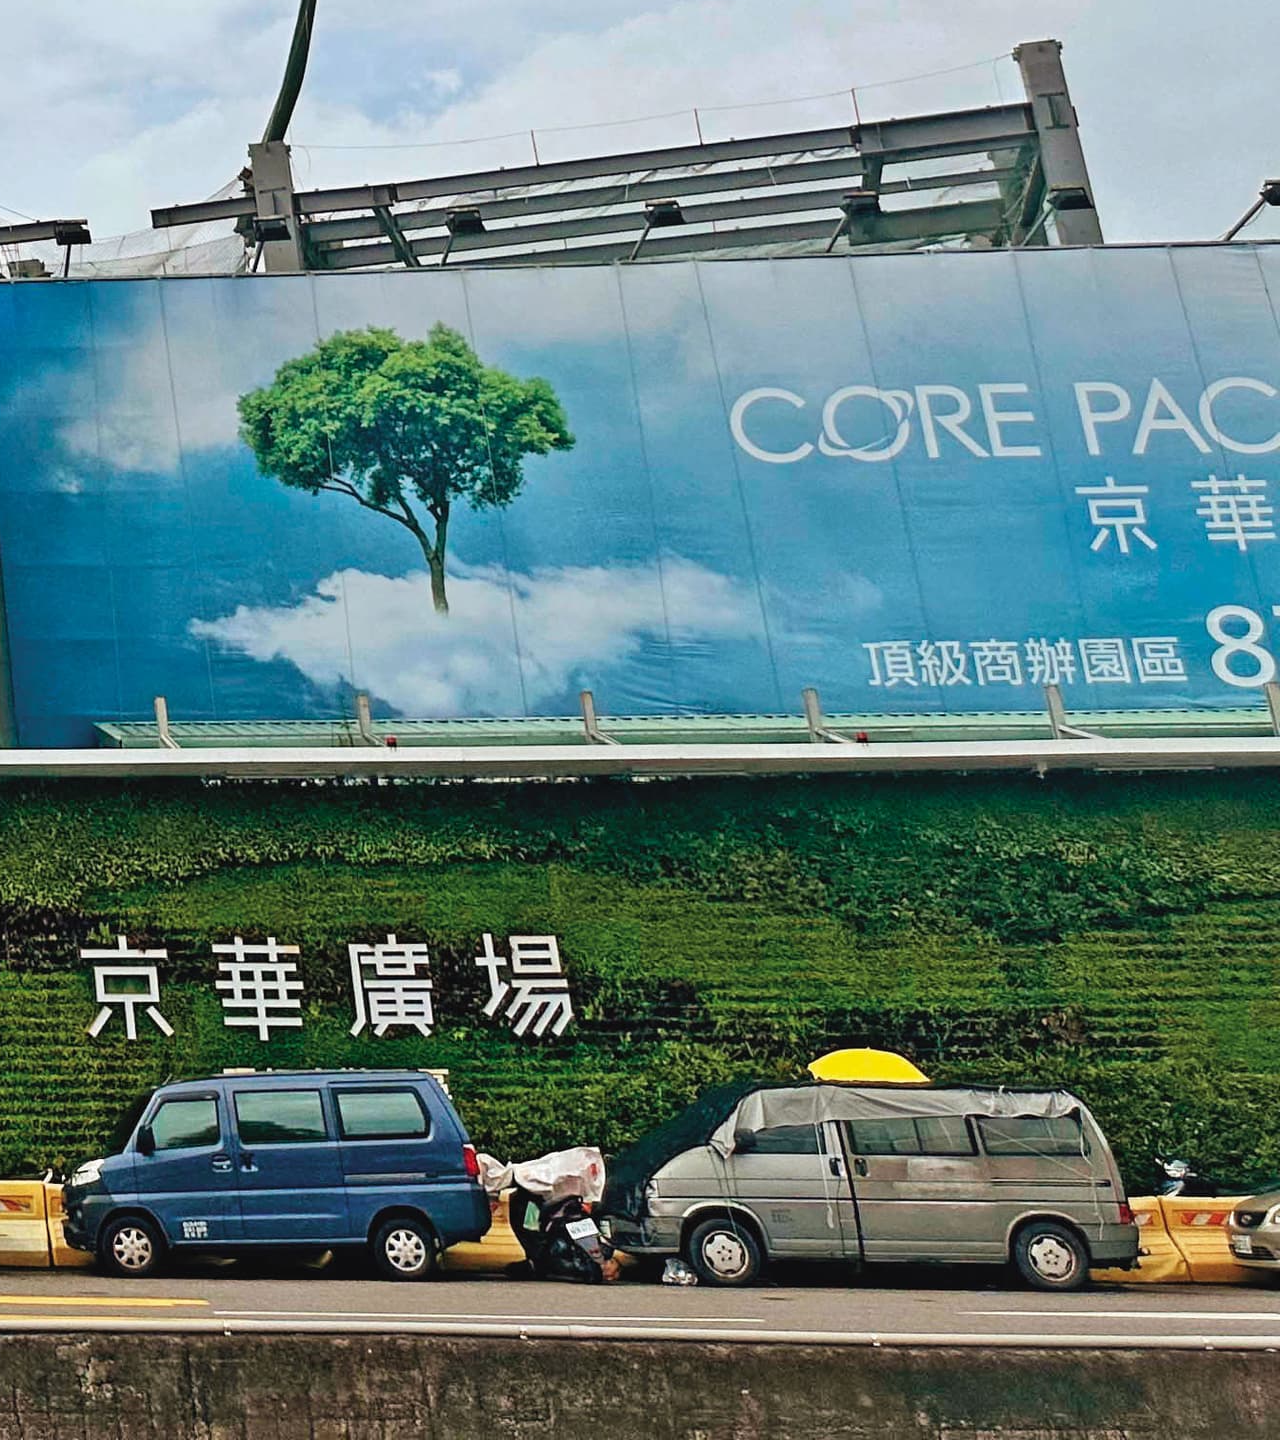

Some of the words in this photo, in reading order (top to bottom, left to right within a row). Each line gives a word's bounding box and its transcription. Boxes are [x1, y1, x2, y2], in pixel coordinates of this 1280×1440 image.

[729, 383, 1042, 463] CORE
[862, 637, 1188, 687] 頂級商辦園區
[1206, 605, 1280, 687] 8
[80, 933, 574, 1041] 京華廣場
